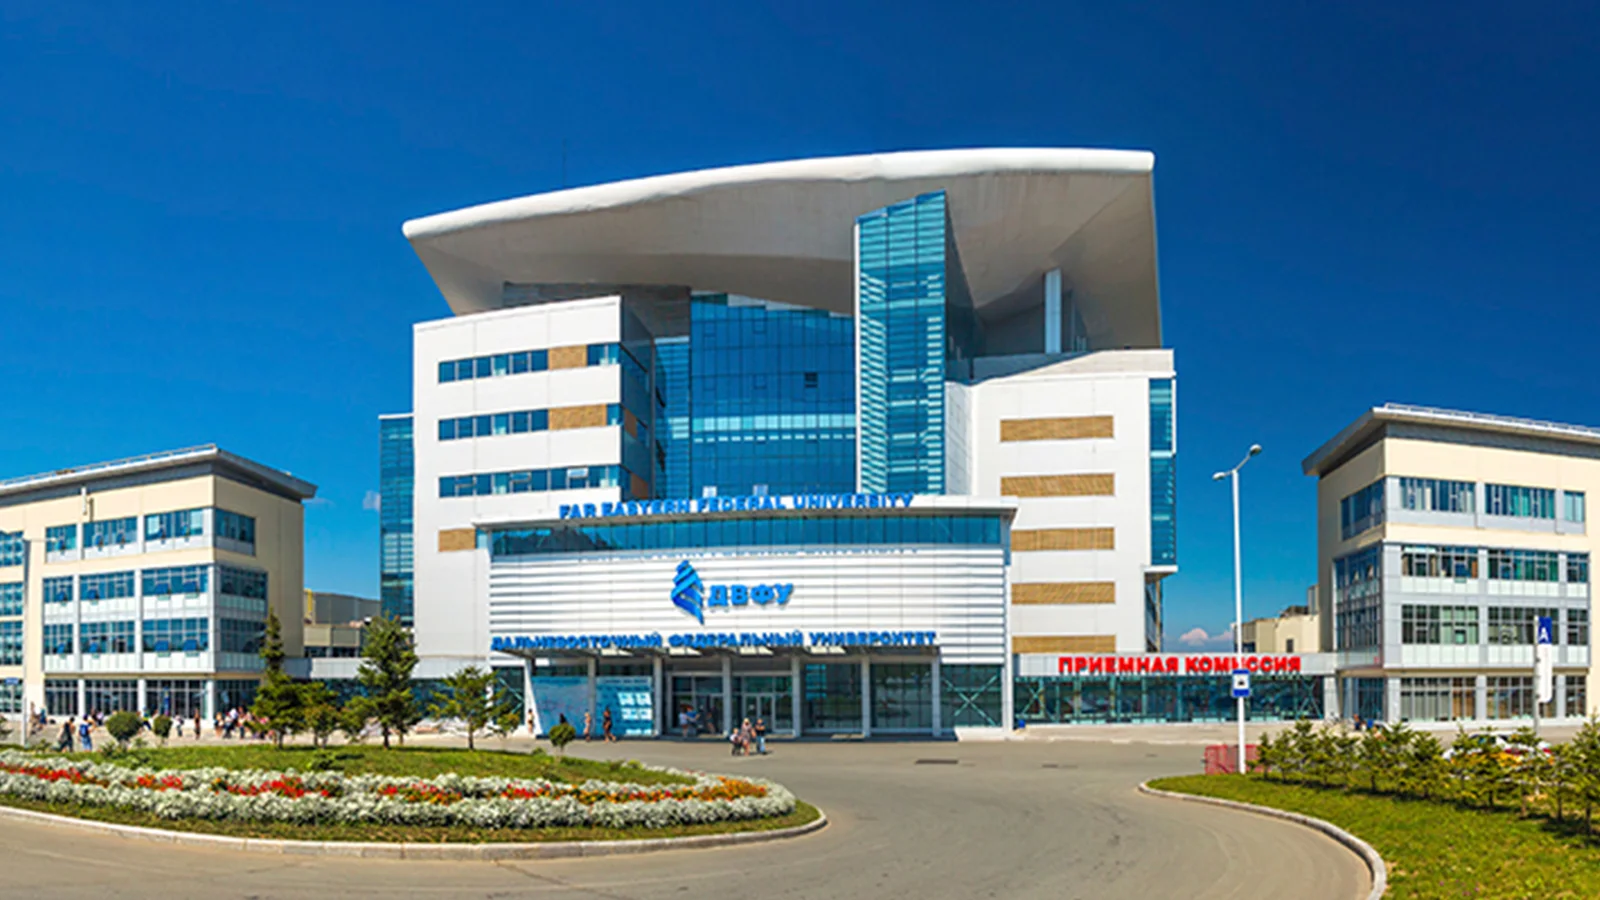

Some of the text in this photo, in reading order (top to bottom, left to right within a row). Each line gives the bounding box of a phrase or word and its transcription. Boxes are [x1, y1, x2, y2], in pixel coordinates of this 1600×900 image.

[559, 492, 914, 519] FAR EASTERN FEDERAL UNIVERSITY
[708, 583, 794, 608] ДВФУ
[491, 629, 937, 650] ДАЛЬНЕВОСТОЧНЫЙ ФЕДЕРАЛЬНЫЙ УНИВЕРСИТЕТ
[1058, 656, 1179, 674] ПРИЕМНАЯ
